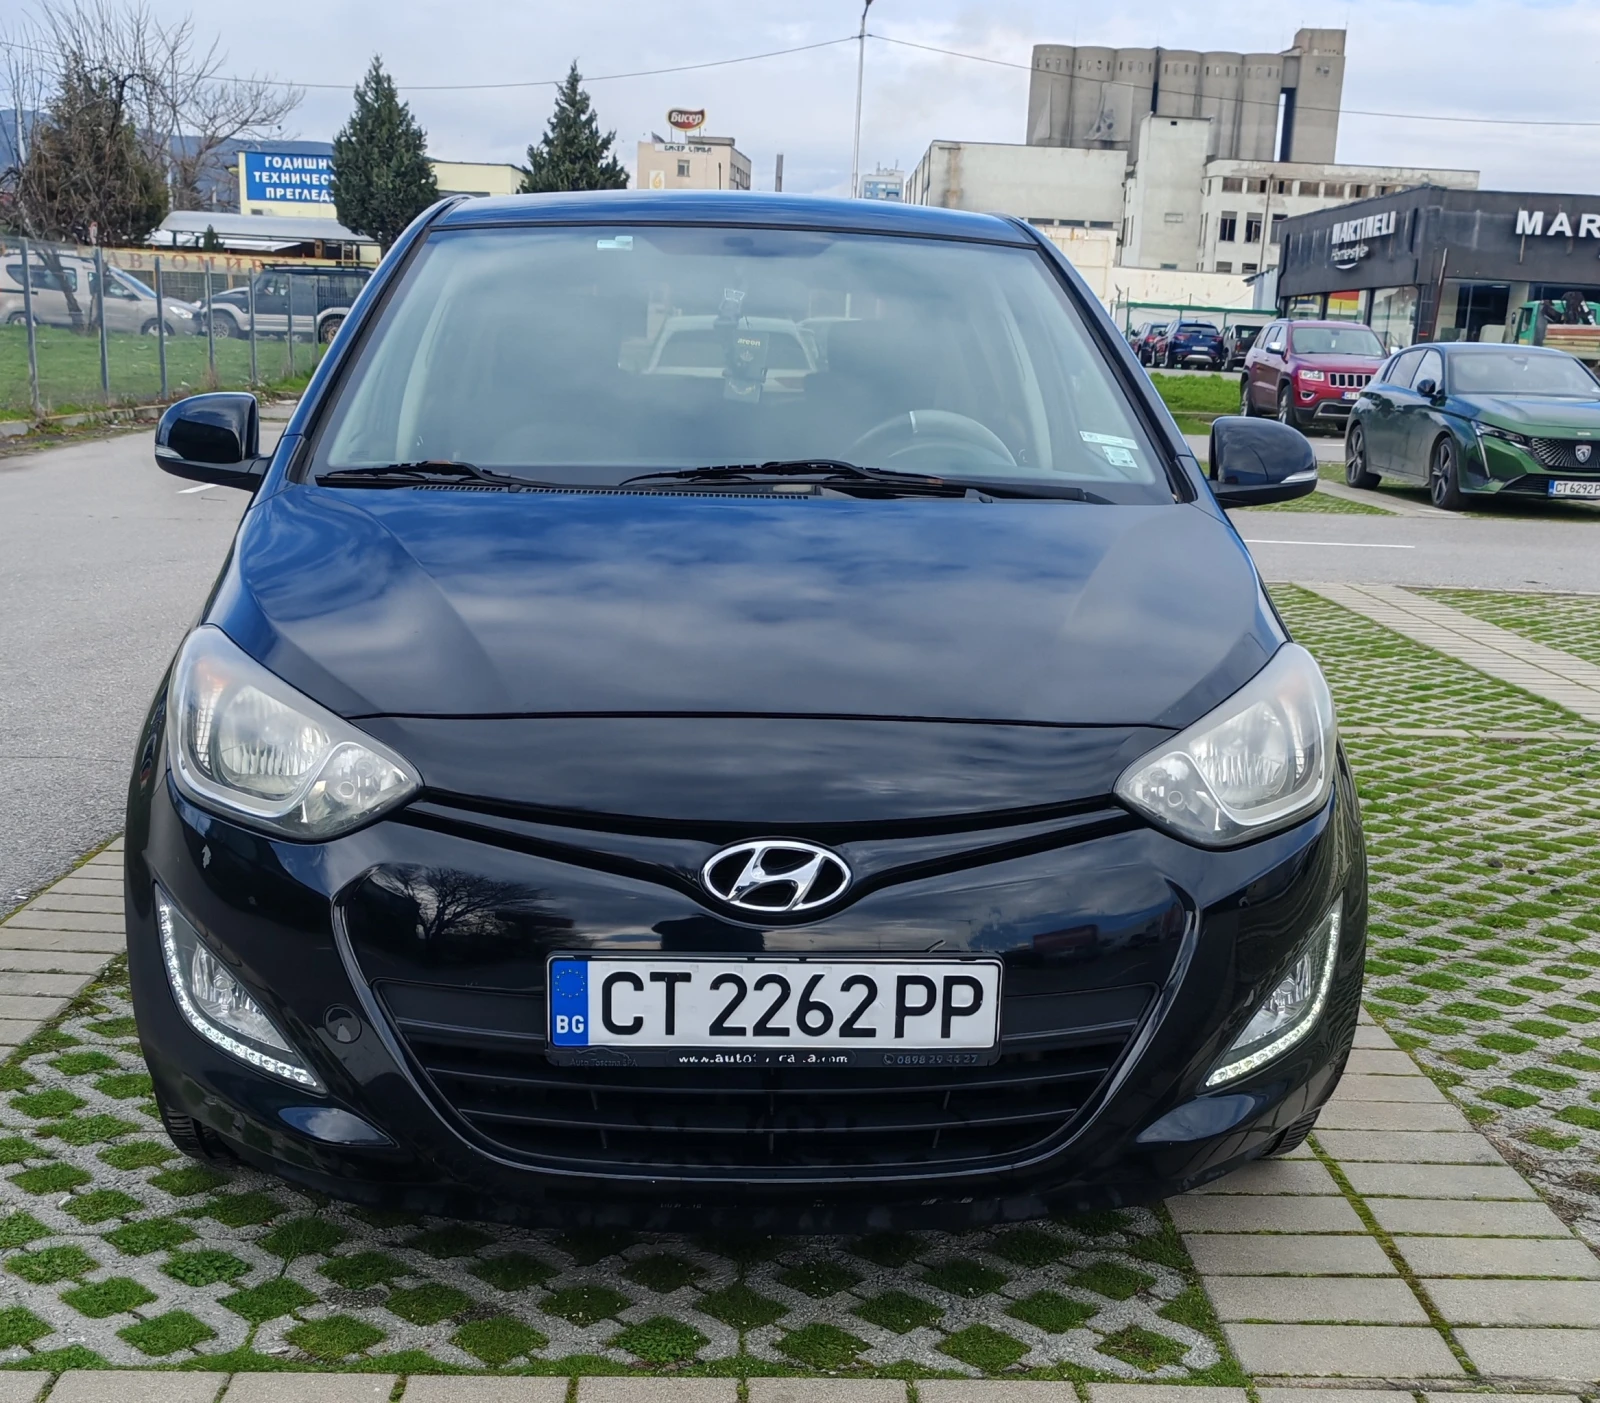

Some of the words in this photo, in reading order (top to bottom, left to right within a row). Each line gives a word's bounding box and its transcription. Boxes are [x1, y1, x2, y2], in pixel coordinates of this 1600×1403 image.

[671, 112, 702, 125] Бисер
[1331, 211, 1396, 245] MARTINELI
[1515, 210, 1600, 238] MAR
[602, 971, 692, 1036] CT
[709, 973, 878, 1038] 2262
[894, 975, 984, 1039] PP
[556, 1015, 585, 1034] BG
